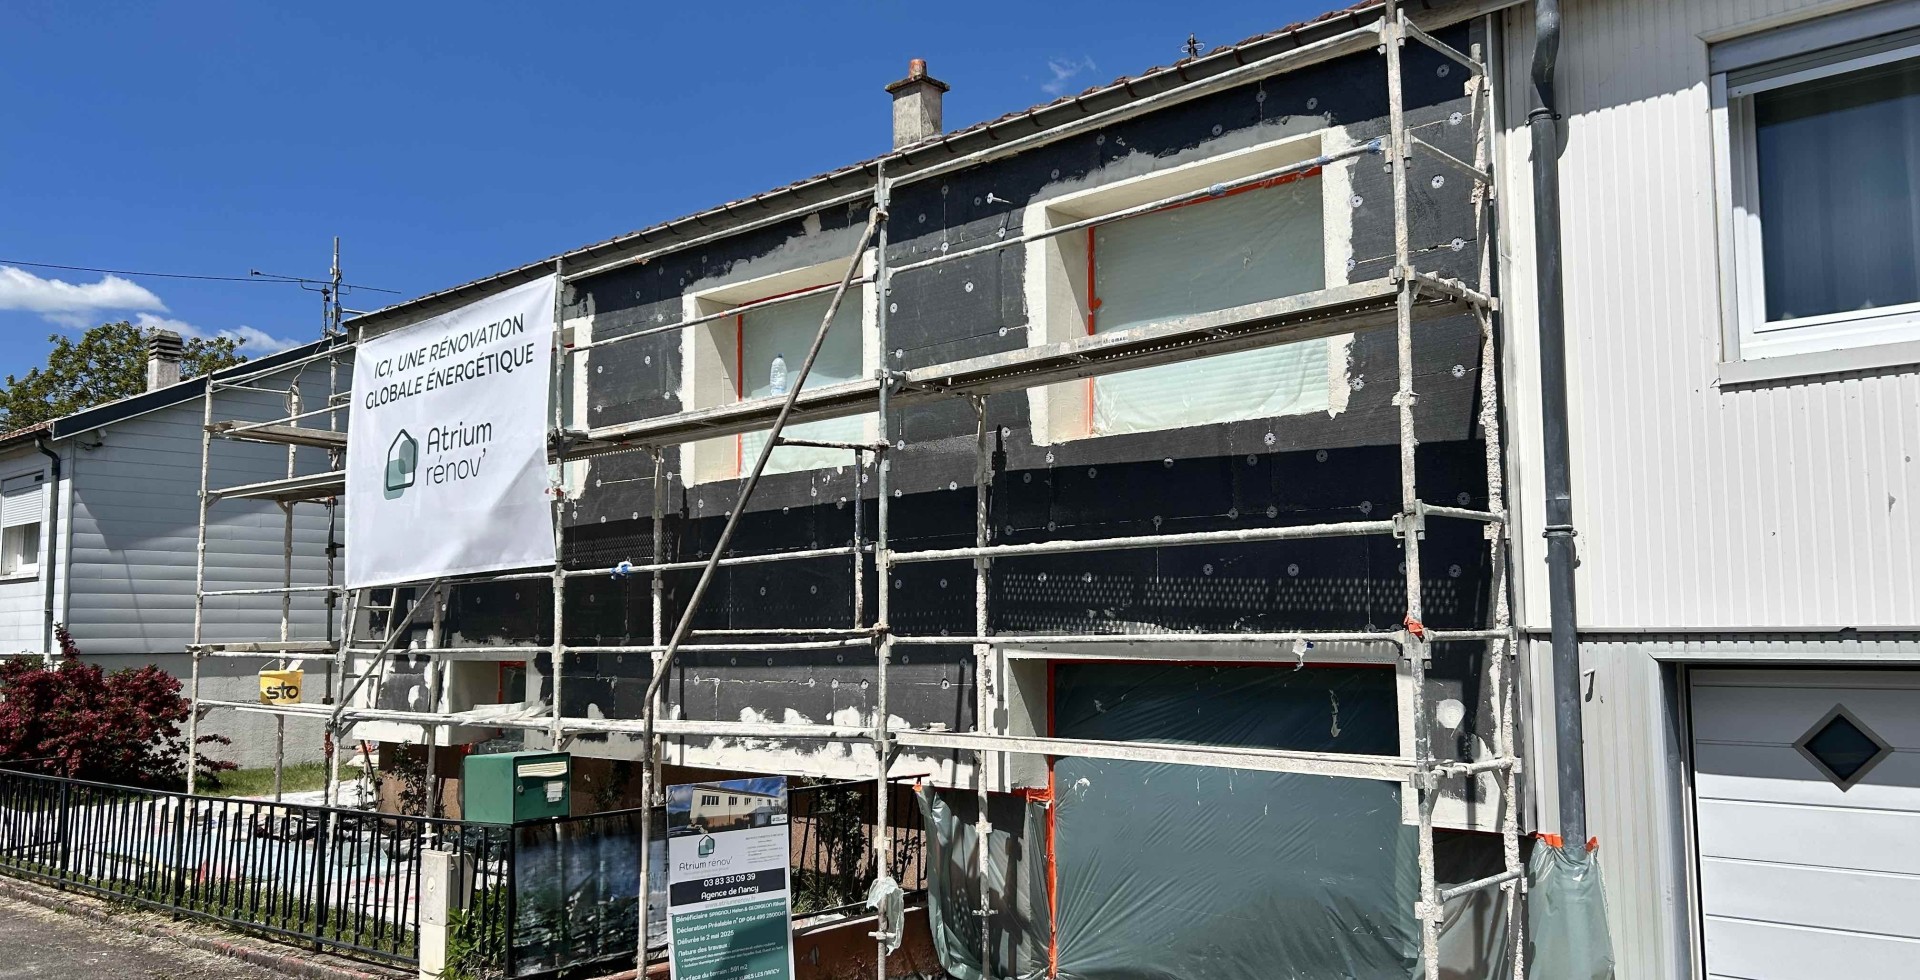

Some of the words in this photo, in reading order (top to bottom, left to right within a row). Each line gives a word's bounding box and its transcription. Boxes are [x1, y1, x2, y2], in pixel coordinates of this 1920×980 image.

[374, 358, 394, 379] ICI,
[398, 347, 427, 372] UNE
[429, 313, 524, 363] RÉNOVATION
[365, 376, 423, 409] GLOBALE
[426, 343, 535, 392] ÉNERGÉTIQUE
[426, 421, 492, 455] Atrium
[679, 860, 706, 871] Atrium
[703, 879, 714, 887] 03
[715, 877, 725, 886] 83
[725, 875, 735, 884] 33
[735, 874, 746, 882] 09
[746, 872, 756, 881] 39
[701, 890, 727, 900] Agence
[728, 887, 737, 895] de
[738, 885, 759, 894] Nancy
[676, 924, 708, 934] Déclaration
[711, 932, 720, 940] mai
[720, 930, 735, 938] 2025
[678, 949, 697, 957] Nature
[702, 971, 709, 979] du
